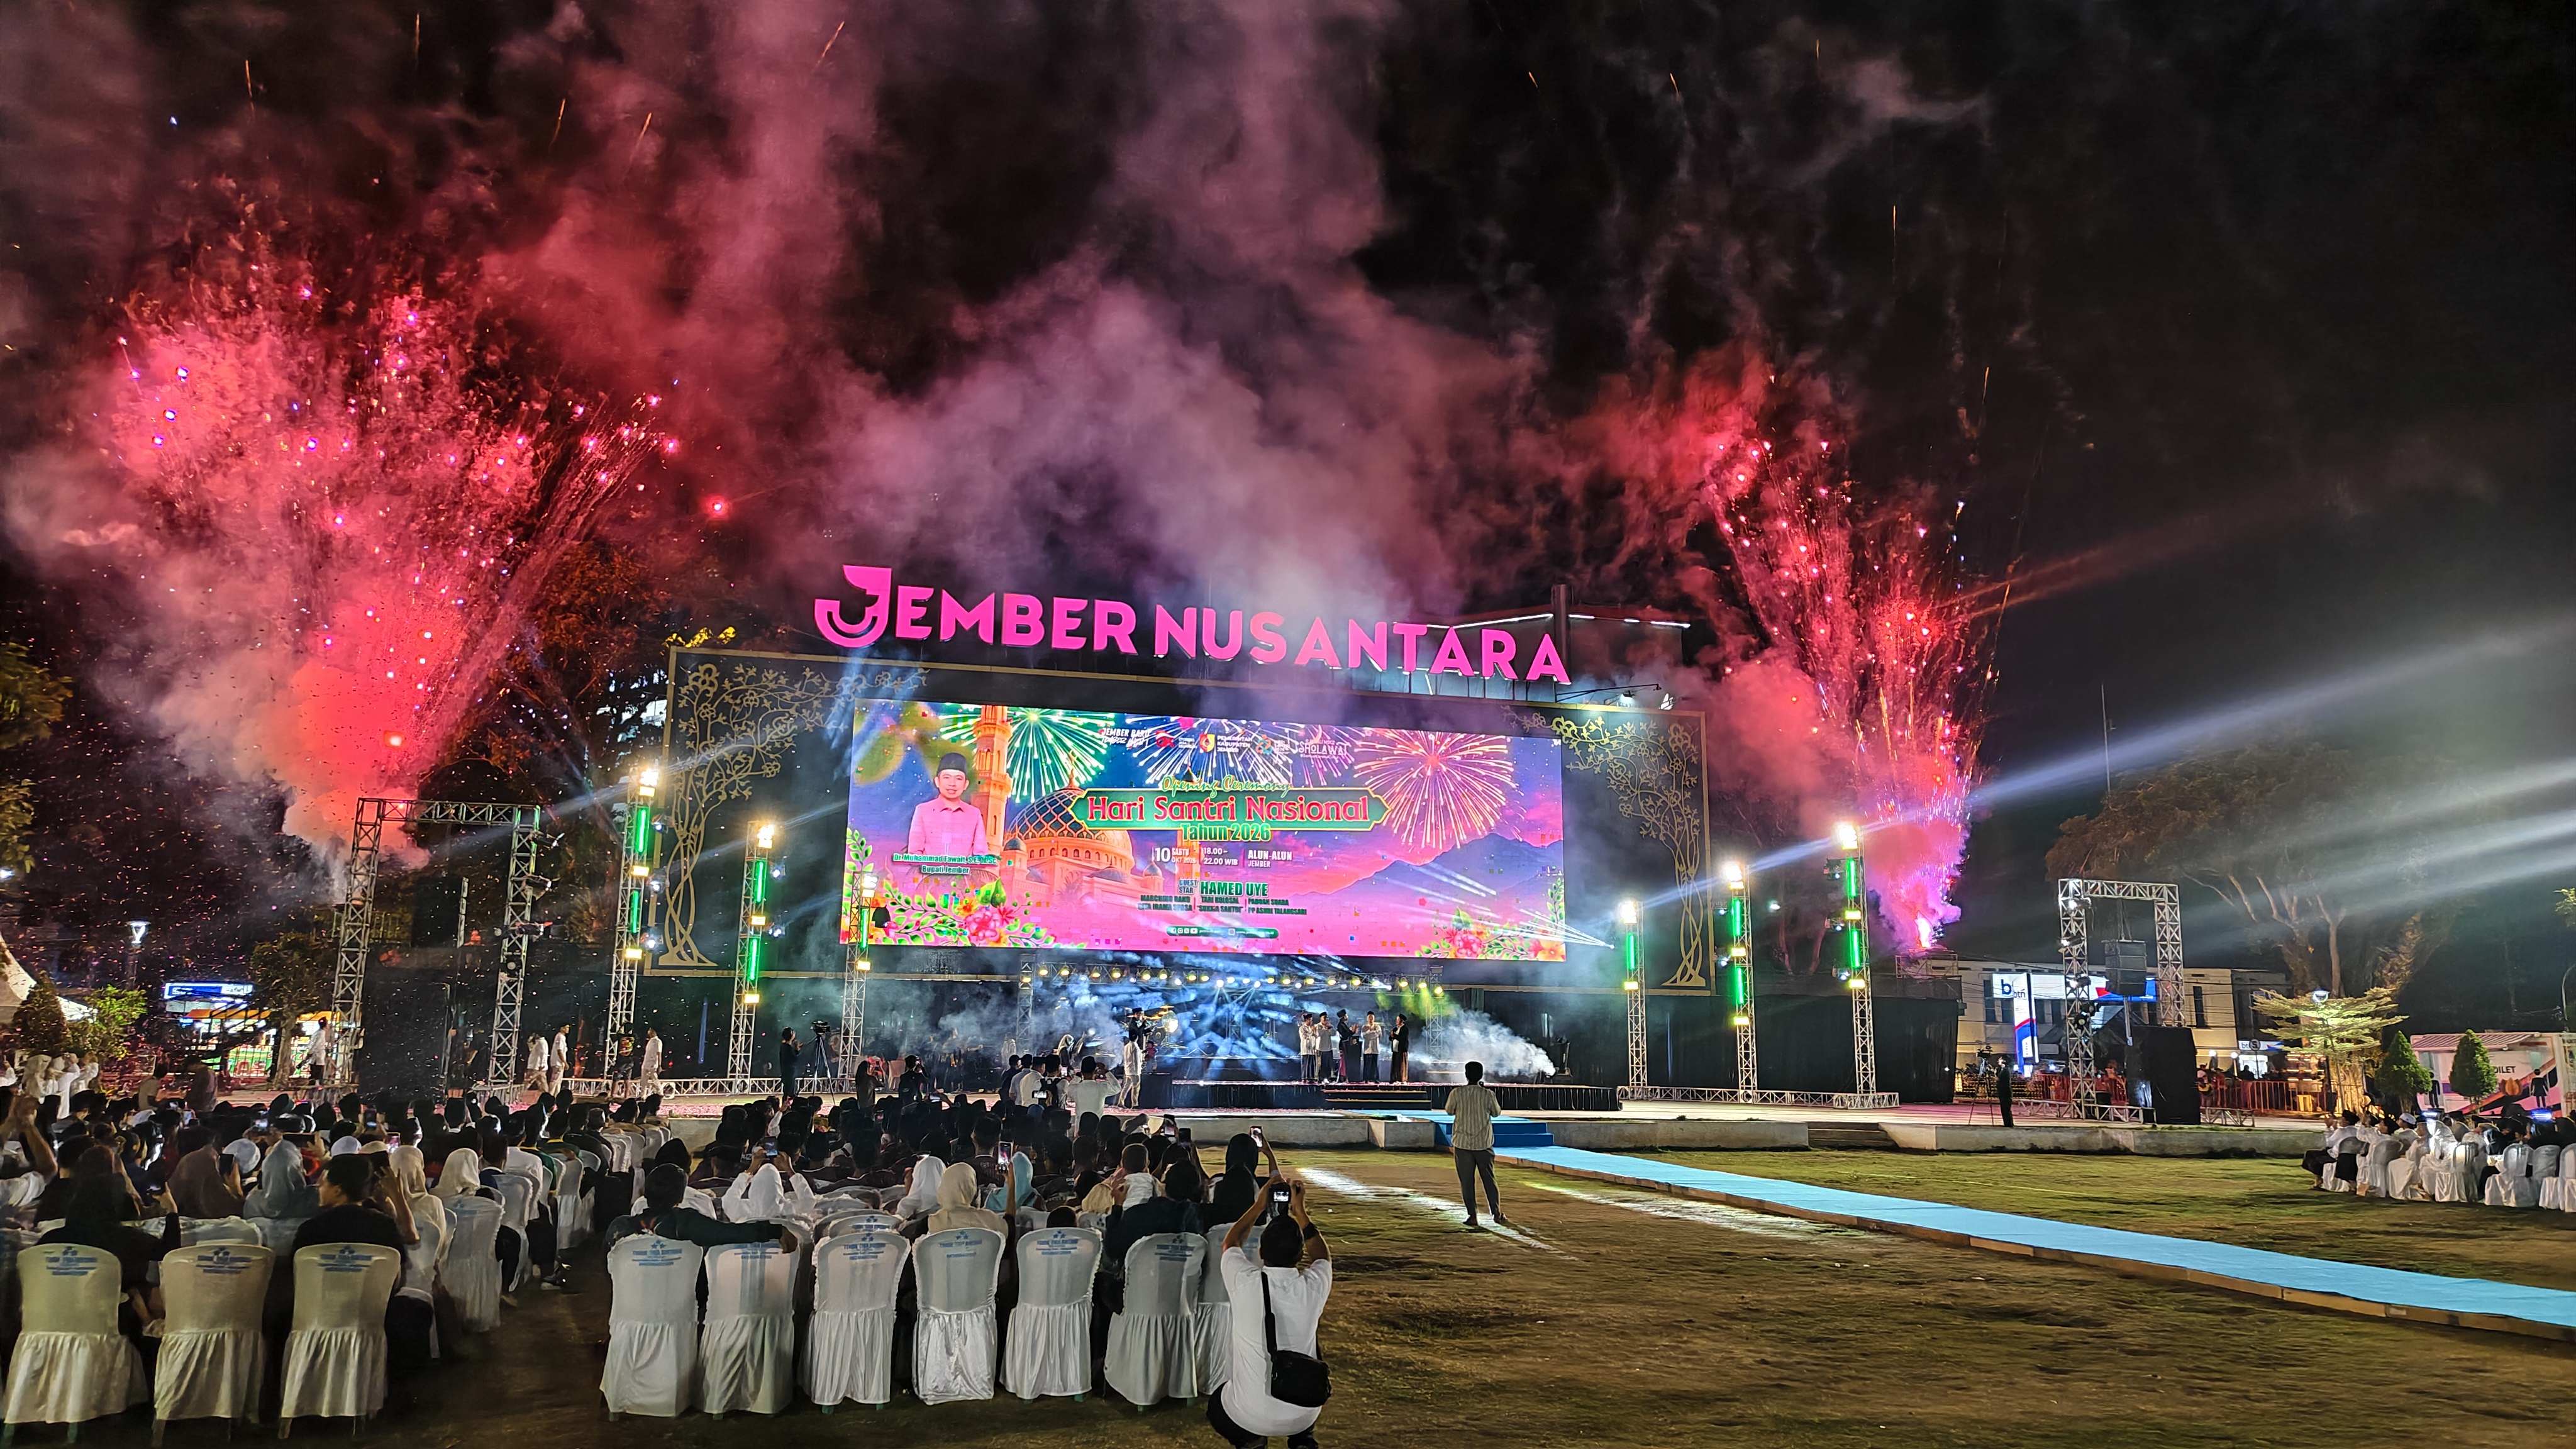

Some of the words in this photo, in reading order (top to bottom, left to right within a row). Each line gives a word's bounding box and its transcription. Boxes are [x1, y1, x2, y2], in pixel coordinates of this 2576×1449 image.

[814, 564, 1138, 655] JEMBER
[1154, 604, 1570, 684] NUSANTARA
[1102, 728, 1129, 736] JEMBER
[1298, 741, 1352, 755] SHOLAWAT
[1162, 774, 1219, 798] Opening
[1222, 774, 1291, 798] Ceremony
[1087, 796, 1145, 821] Hari
[1153, 795, 1237, 822] Santri
[1245, 795, 1369, 823] Nasional
[1181, 823, 1228, 841] Tahun
[1230, 823, 1271, 842] 2026
[893, 853, 903, 861] Dr.
[904, 853, 943, 863] Muhammad
[1155, 847, 1170, 862] 10
[1172, 848, 1190, 856] SABTU
[1247, 850, 1292, 861] ALUN-ALUN
[922, 865, 944, 874] Bupati
[945, 865, 970, 874] Jember
[1200, 881, 1243, 896] HAMED
[1245, 882, 1269, 896] UYE
